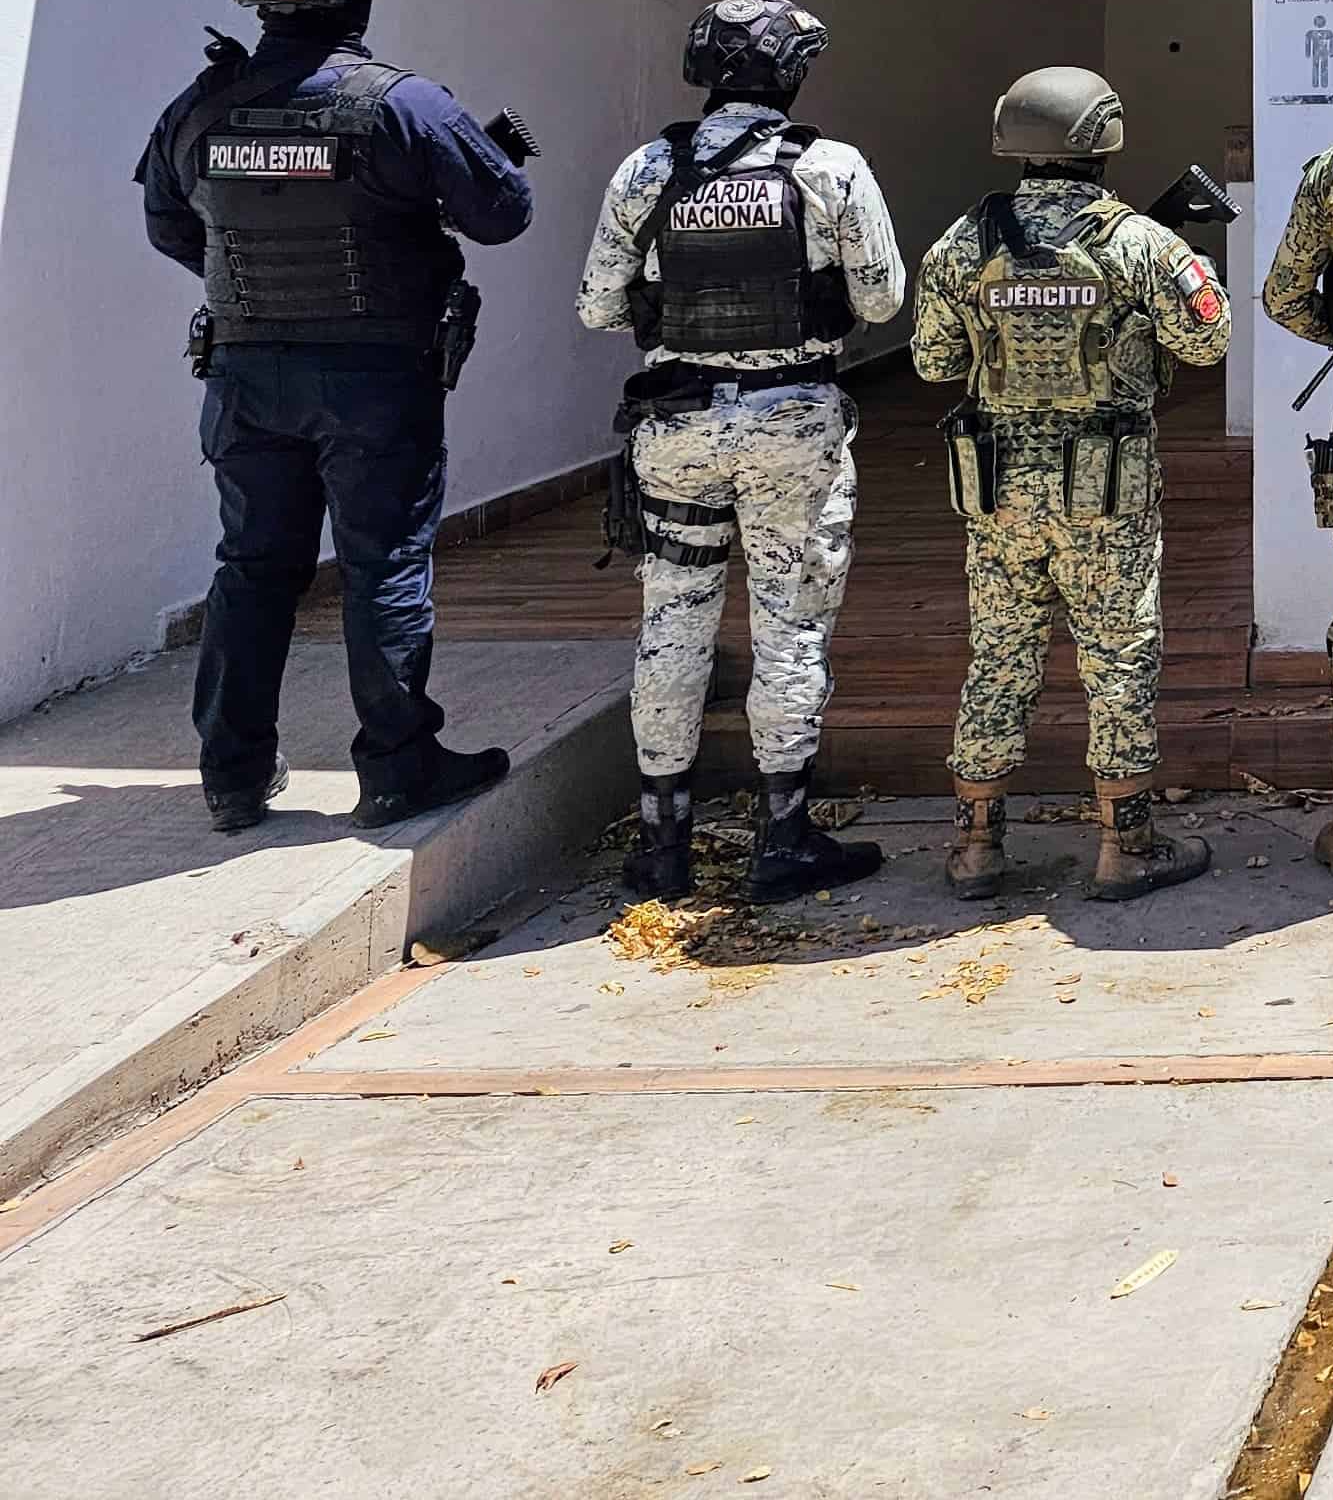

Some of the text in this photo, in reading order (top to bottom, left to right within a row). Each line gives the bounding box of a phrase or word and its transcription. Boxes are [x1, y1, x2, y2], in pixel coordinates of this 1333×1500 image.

[208, 139, 332, 170] POLICÍA ESTATAL
[673, 203, 779, 229] NACIONAL
[988, 283, 1097, 309] EJÉRCITO
